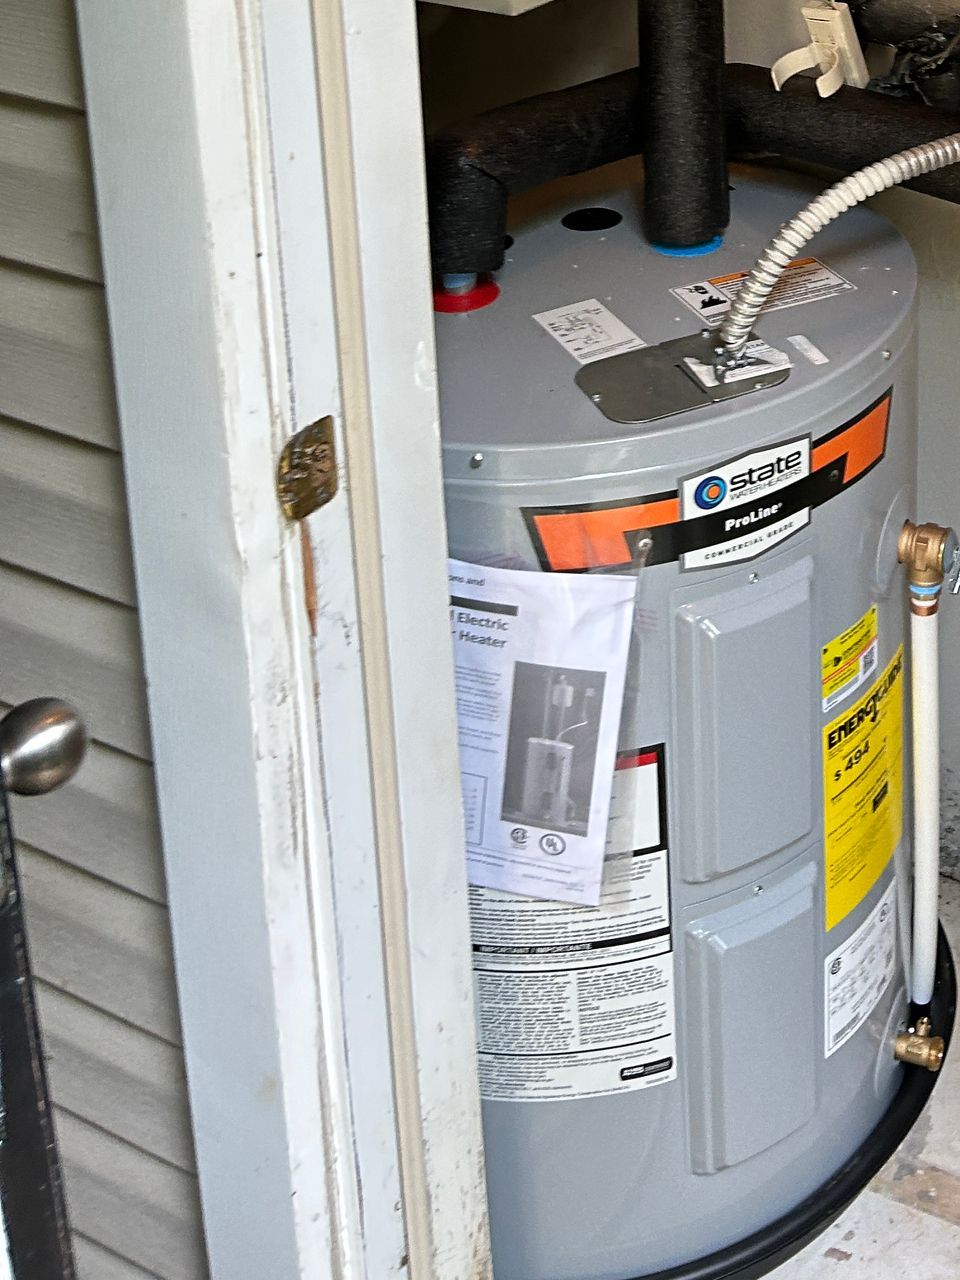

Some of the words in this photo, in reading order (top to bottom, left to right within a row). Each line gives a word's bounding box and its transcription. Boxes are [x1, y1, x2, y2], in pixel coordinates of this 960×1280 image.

[729, 450, 802, 493] state
[457, 612, 510, 631] Electric
[459, 630, 507, 648] Heater
